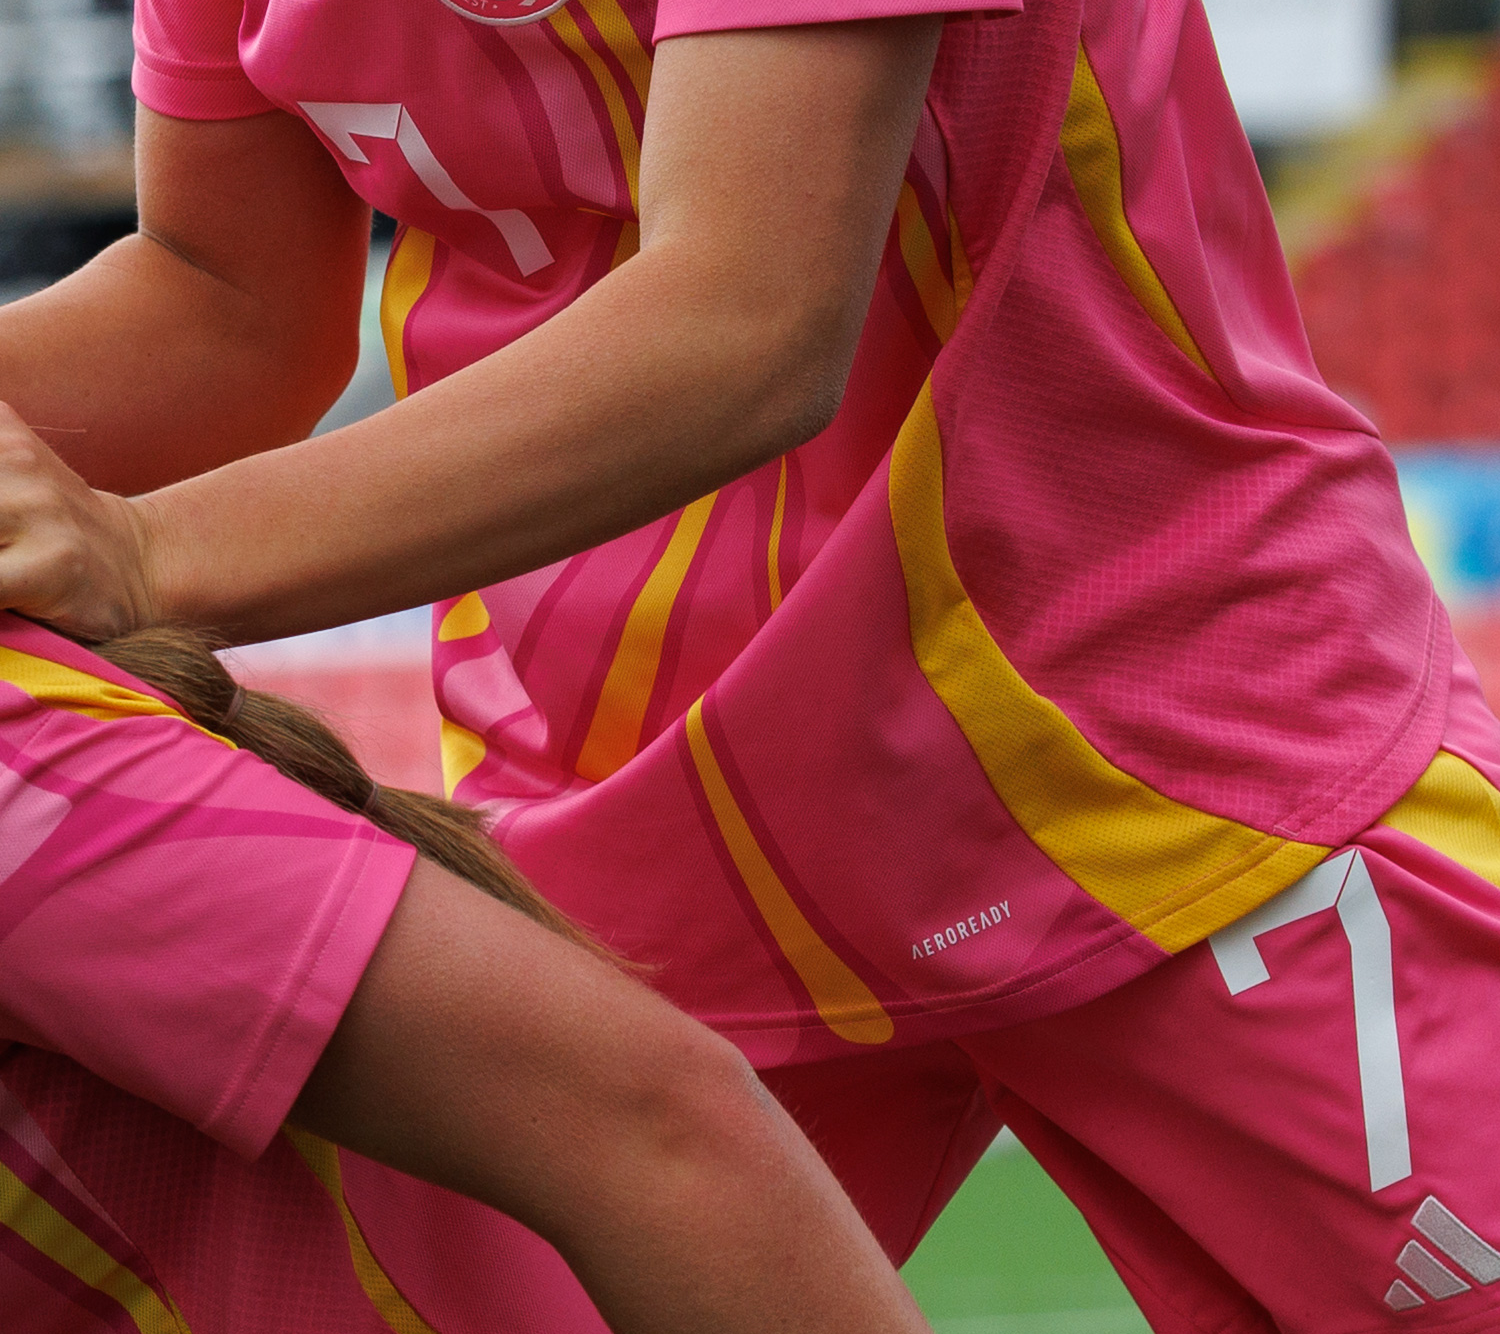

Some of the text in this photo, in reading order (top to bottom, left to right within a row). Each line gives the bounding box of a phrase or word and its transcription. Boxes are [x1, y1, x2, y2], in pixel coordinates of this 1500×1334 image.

[297, 101, 555, 277] 7
[912, 900, 1011, 960] AEROREADY
[1206, 847, 1413, 1192] 7
